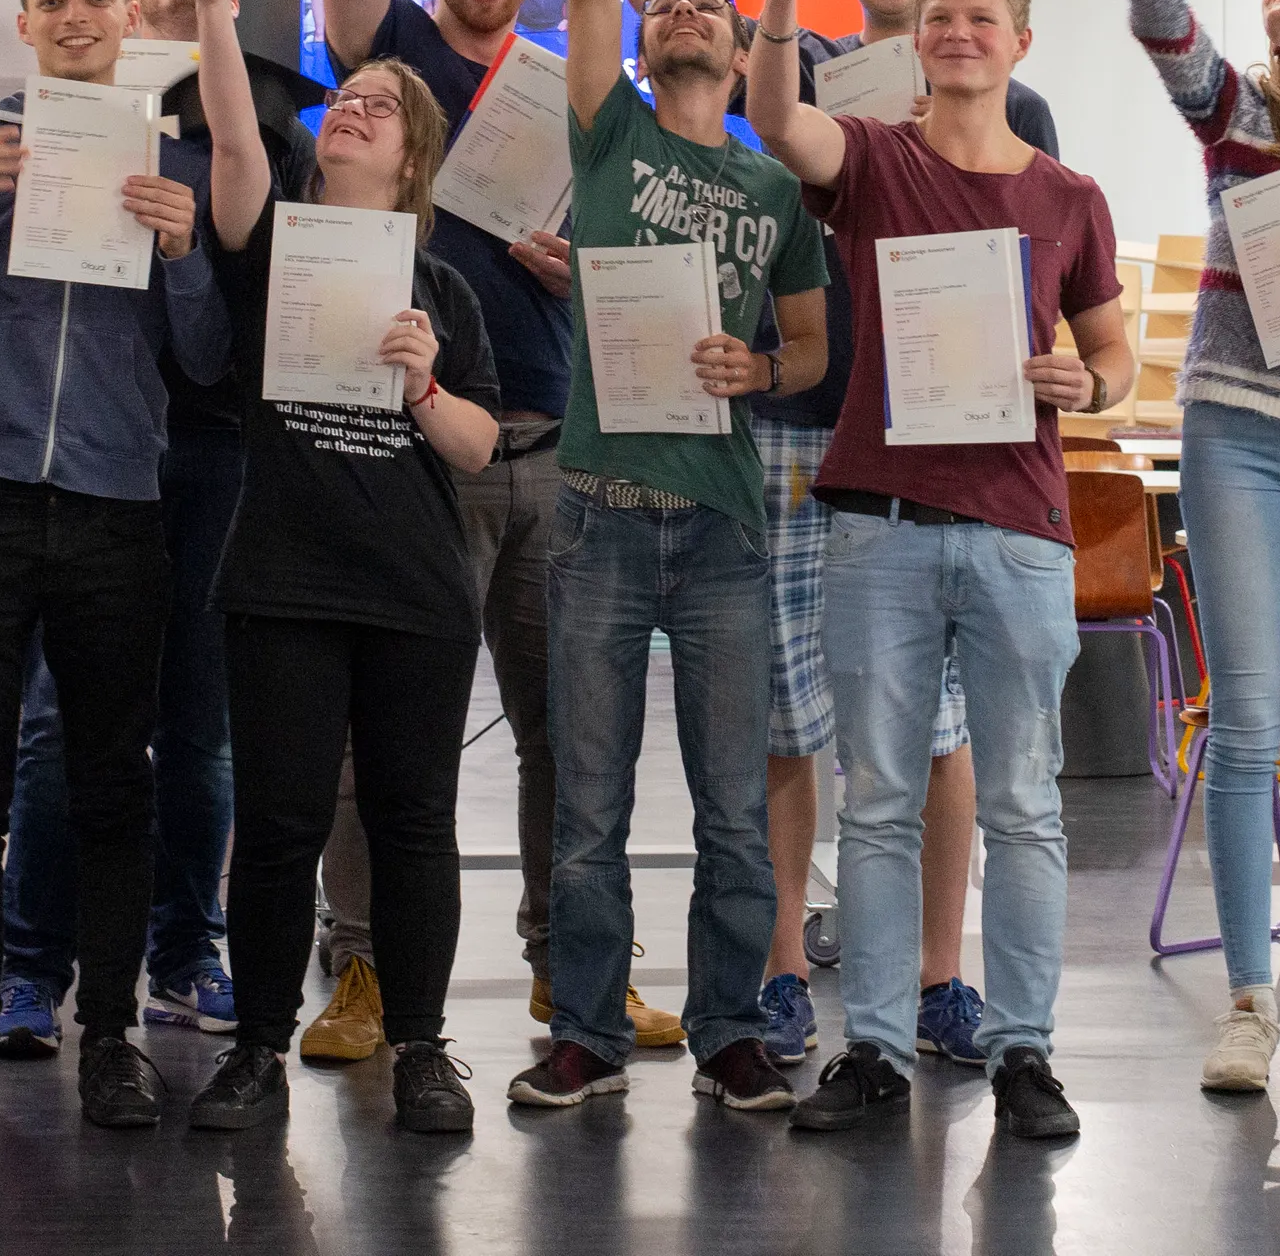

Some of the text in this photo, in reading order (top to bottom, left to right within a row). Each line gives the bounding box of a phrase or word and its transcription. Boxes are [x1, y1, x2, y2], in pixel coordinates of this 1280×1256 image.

[691, 178, 748, 210] TAHOE
[285, 419, 308, 431] you
[345, 430, 375, 443] your
[376, 418, 390, 431] to
[335, 441, 368, 455] them
[369, 446, 395, 458] too.
